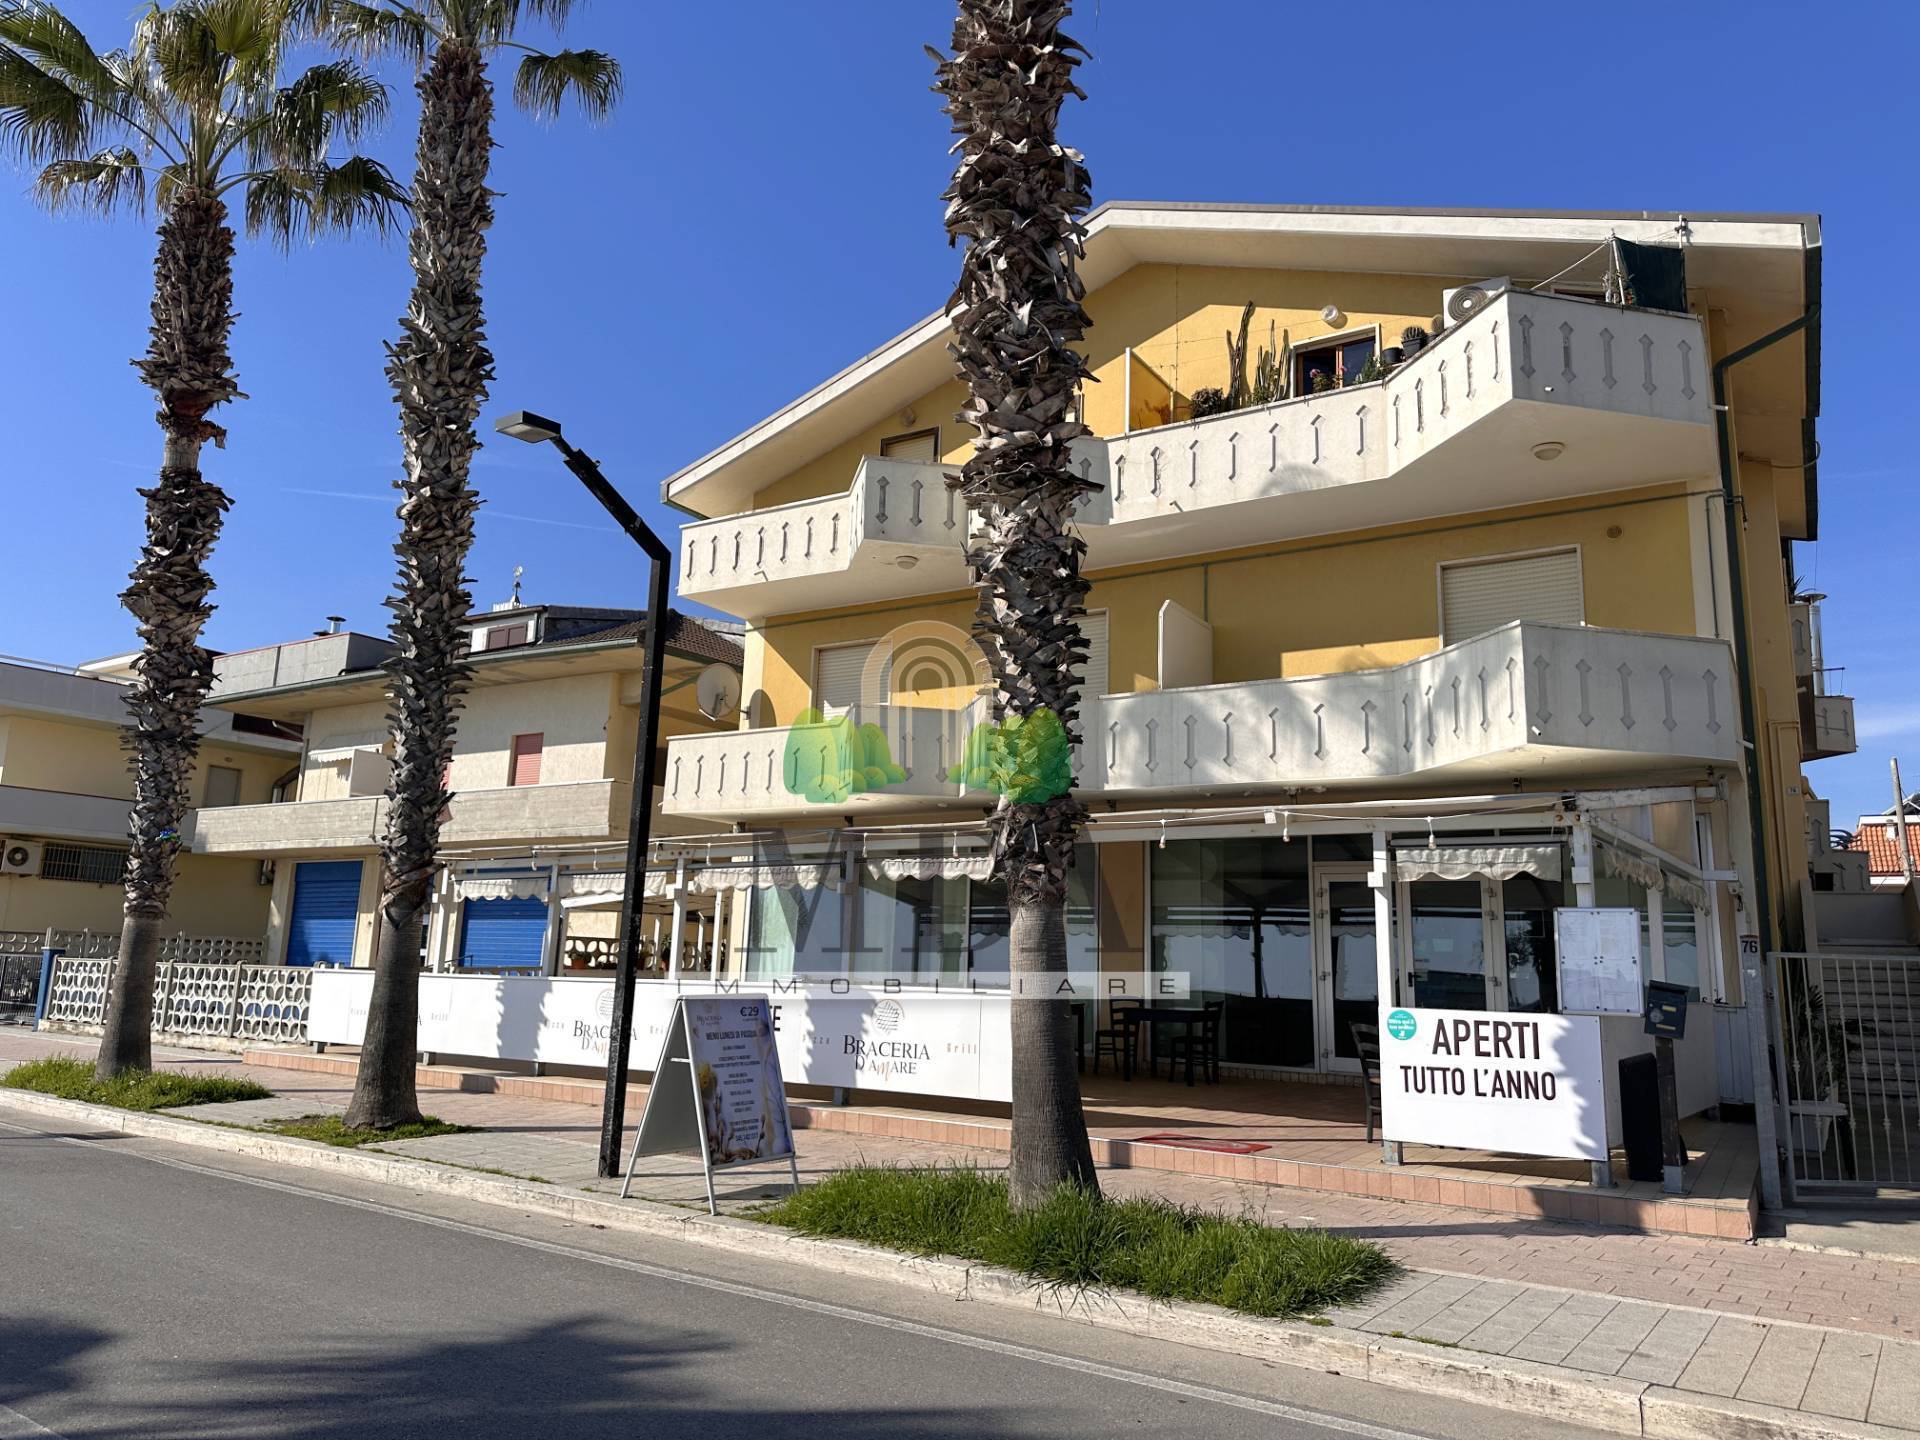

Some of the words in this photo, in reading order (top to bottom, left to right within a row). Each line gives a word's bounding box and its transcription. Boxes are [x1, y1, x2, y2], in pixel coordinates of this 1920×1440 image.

[1742, 940, 1758, 954] 76
[573, 1020, 638, 1040] BRACA
[1432, 1018, 1540, 1060] APERTI
[843, 1034, 930, 1061] BRACERIA
[1399, 1065, 1466, 1096] TUTTO
[1473, 1068, 1557, 1101] L'ANNO
